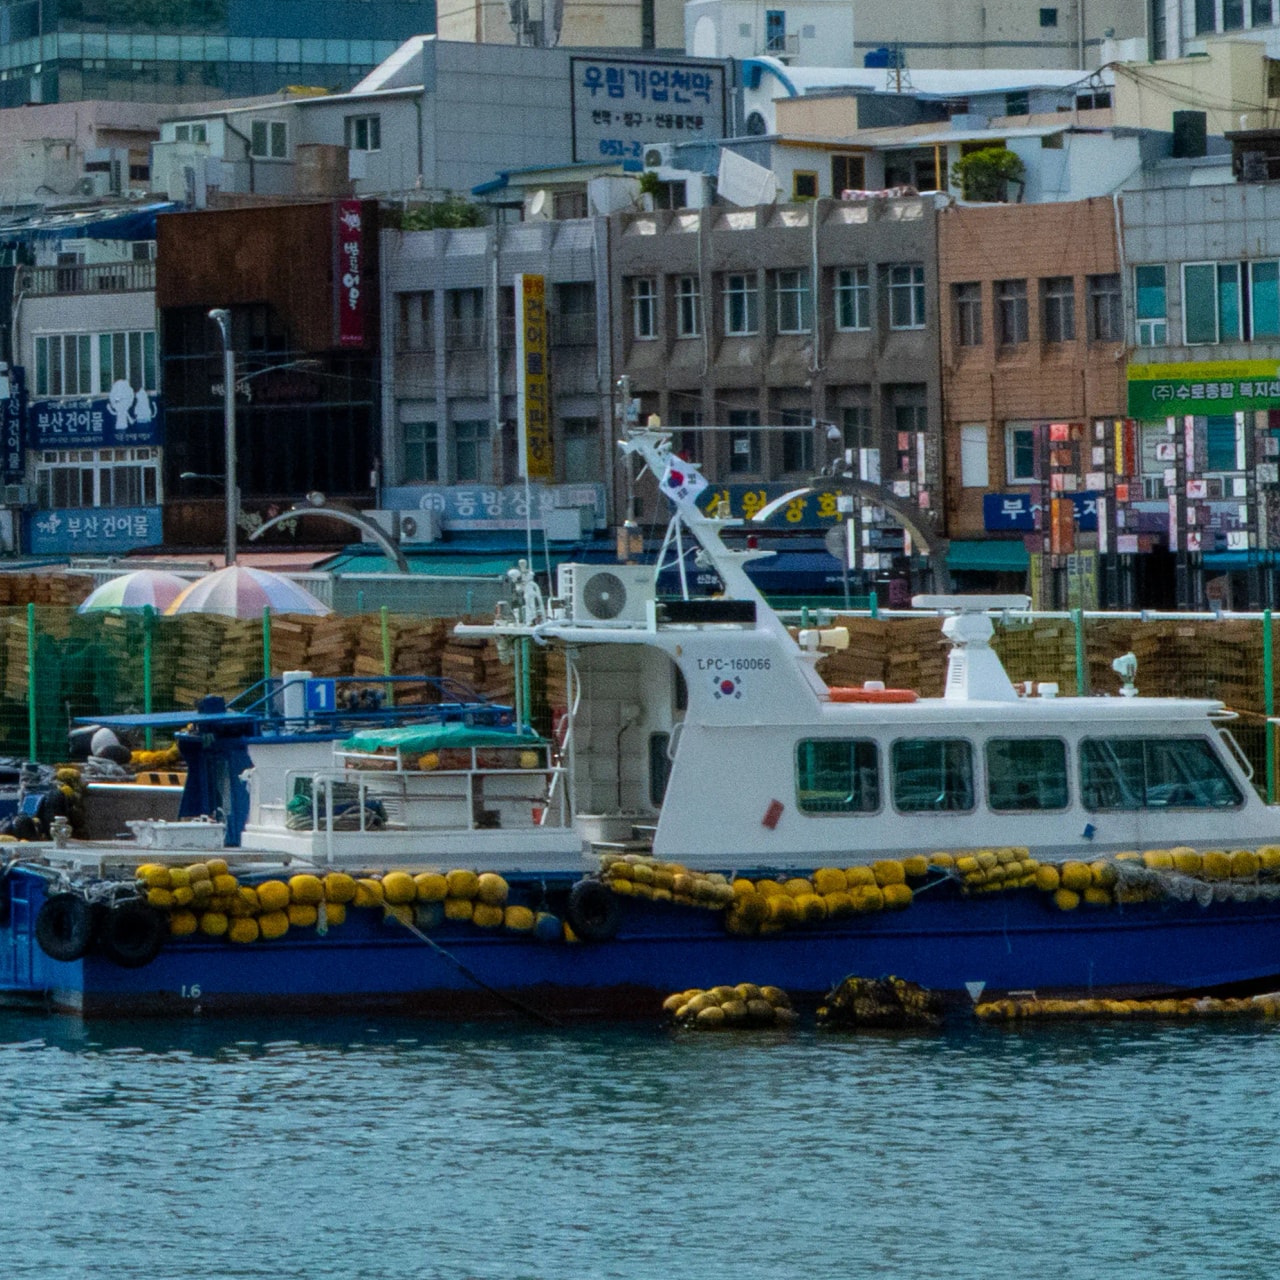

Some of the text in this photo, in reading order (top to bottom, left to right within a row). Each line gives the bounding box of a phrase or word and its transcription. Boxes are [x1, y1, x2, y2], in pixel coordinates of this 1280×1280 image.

[583, 66, 714, 104] 우림기업천막
[37, 410, 104, 434] 부산 건어물
[66, 514, 149, 539] 부산 건어물
